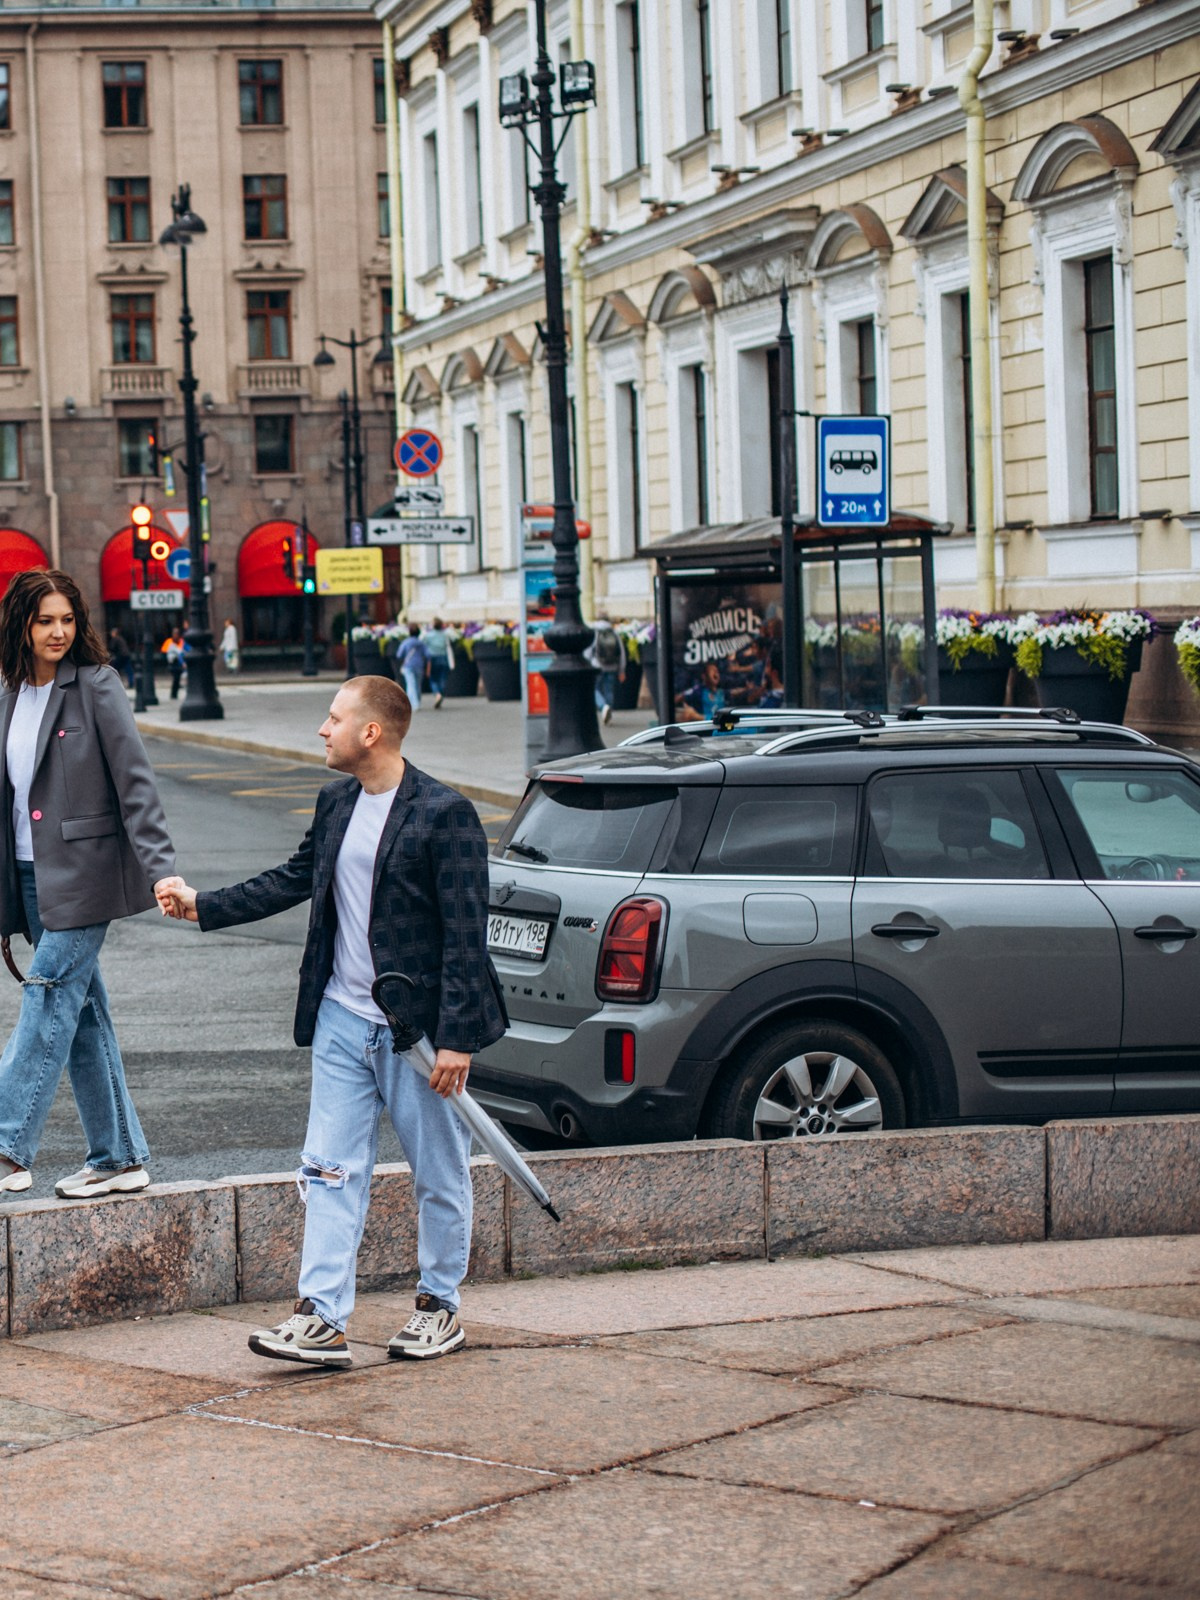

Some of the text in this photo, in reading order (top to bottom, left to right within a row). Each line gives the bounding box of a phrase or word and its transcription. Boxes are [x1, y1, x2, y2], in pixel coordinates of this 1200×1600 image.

[138, 593, 175, 605] СТОП
[689, 607, 761, 639] ЗАРЯДИСЬ
[563, 916, 594, 928] COOPER
[526, 922, 546, 943] 198
